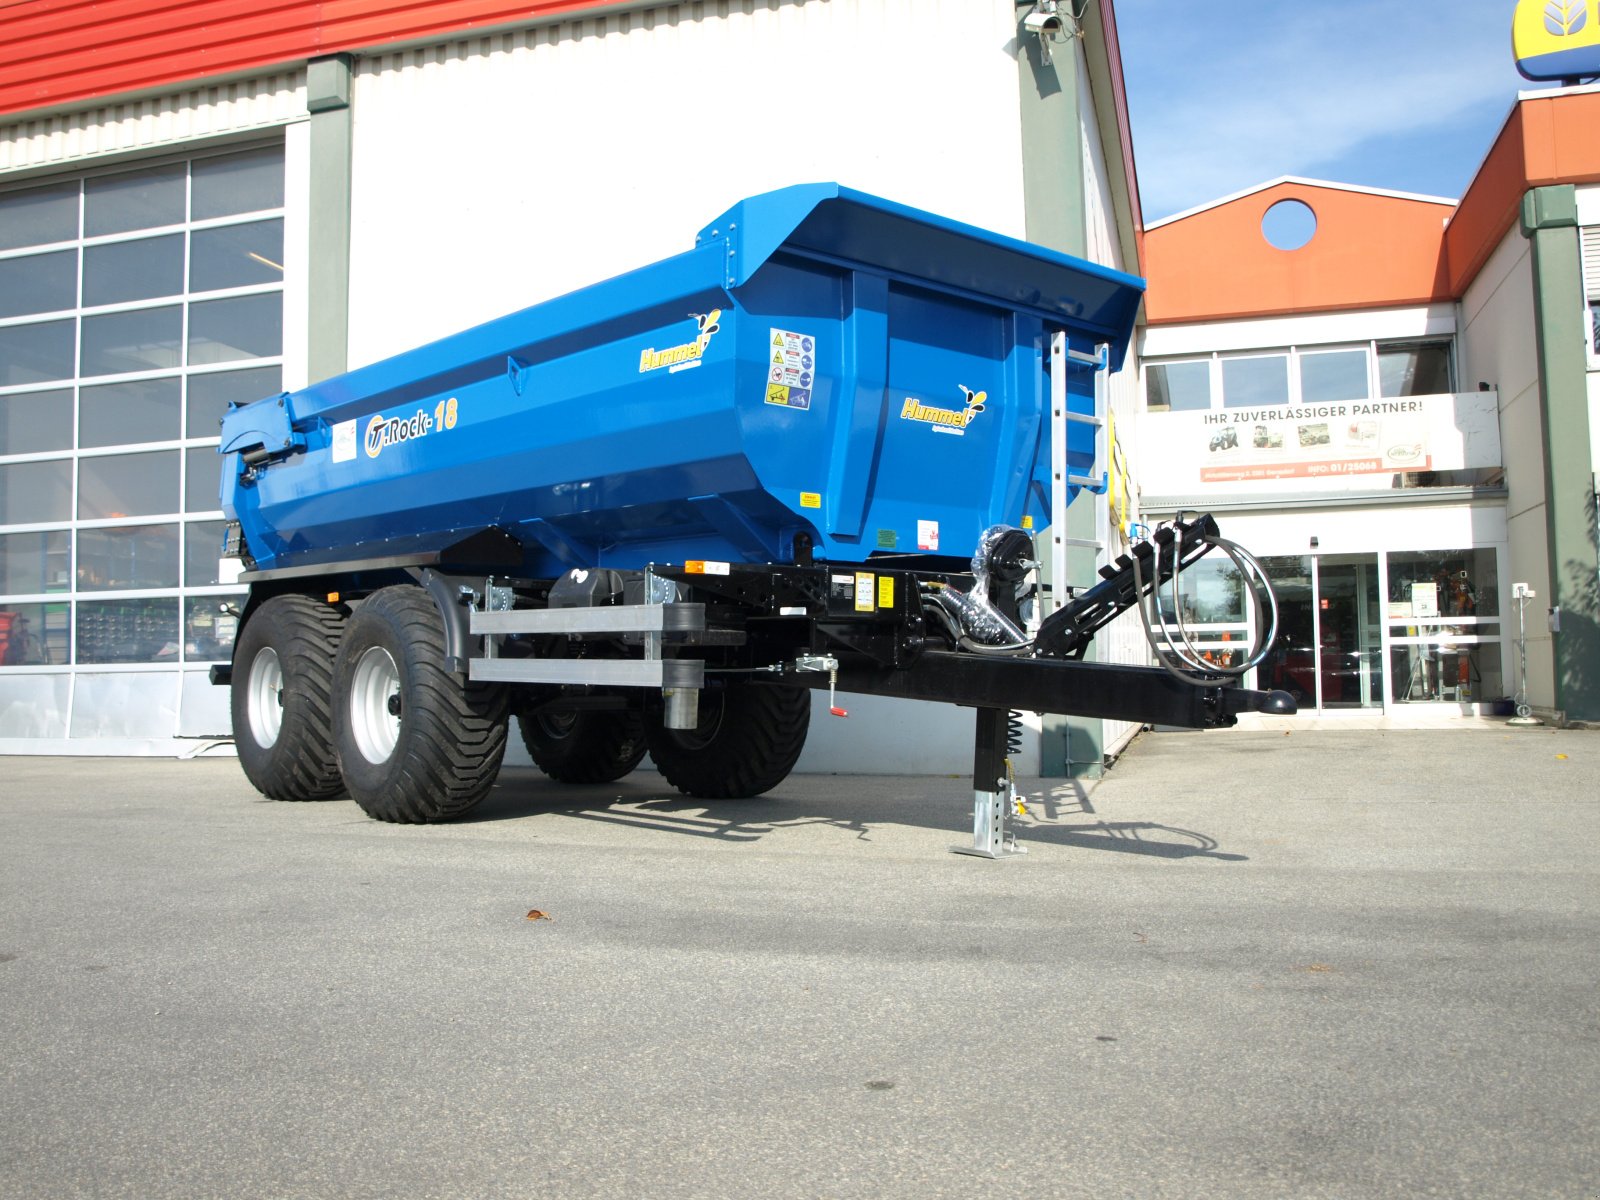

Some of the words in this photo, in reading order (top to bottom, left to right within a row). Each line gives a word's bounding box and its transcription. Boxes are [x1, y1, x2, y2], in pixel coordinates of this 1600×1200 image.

[640, 336, 703, 373] Hummel
[901, 398, 968, 428] Hummel
[1204, 413, 1228, 425] IHR
[1233, 406, 1347, 423] ZUVERLÄSSIGER
[1352, 401, 1423, 416] PARTNER!
